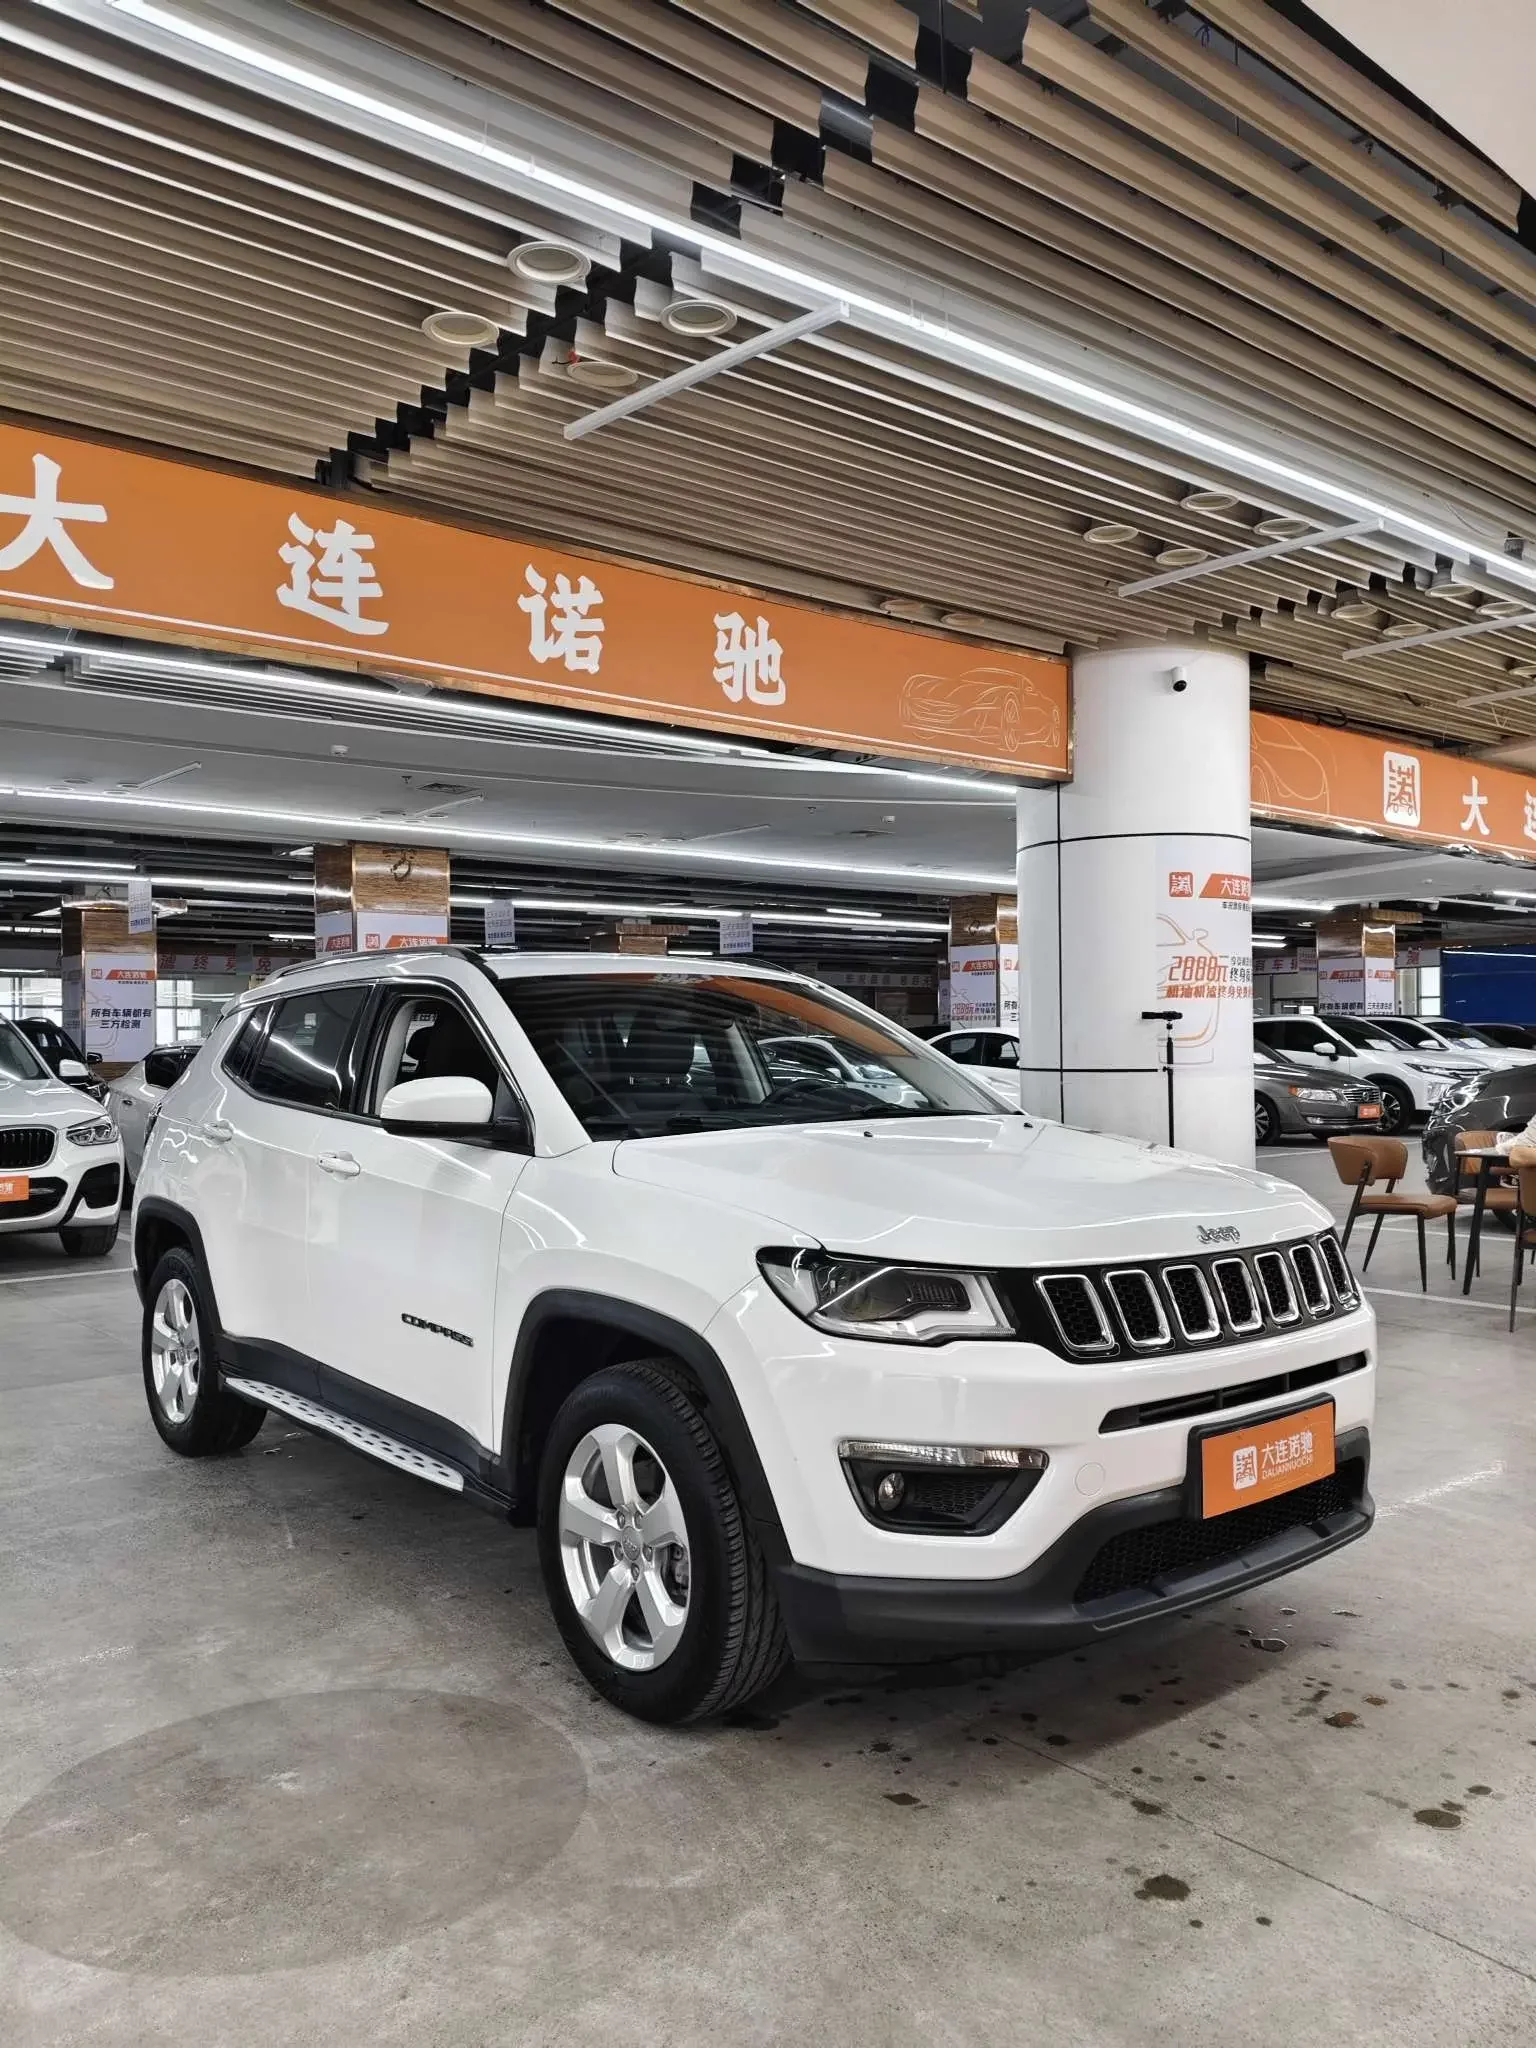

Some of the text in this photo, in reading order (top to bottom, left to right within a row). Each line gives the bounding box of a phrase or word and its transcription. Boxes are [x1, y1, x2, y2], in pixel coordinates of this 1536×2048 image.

[0, 453, 786, 705] 大连诺驰
[91, 1008, 152, 1018] 所有车辆都有
[1197, 1225, 1240, 1244] Jeep
[401, 1312, 474, 1348] COMPASS
